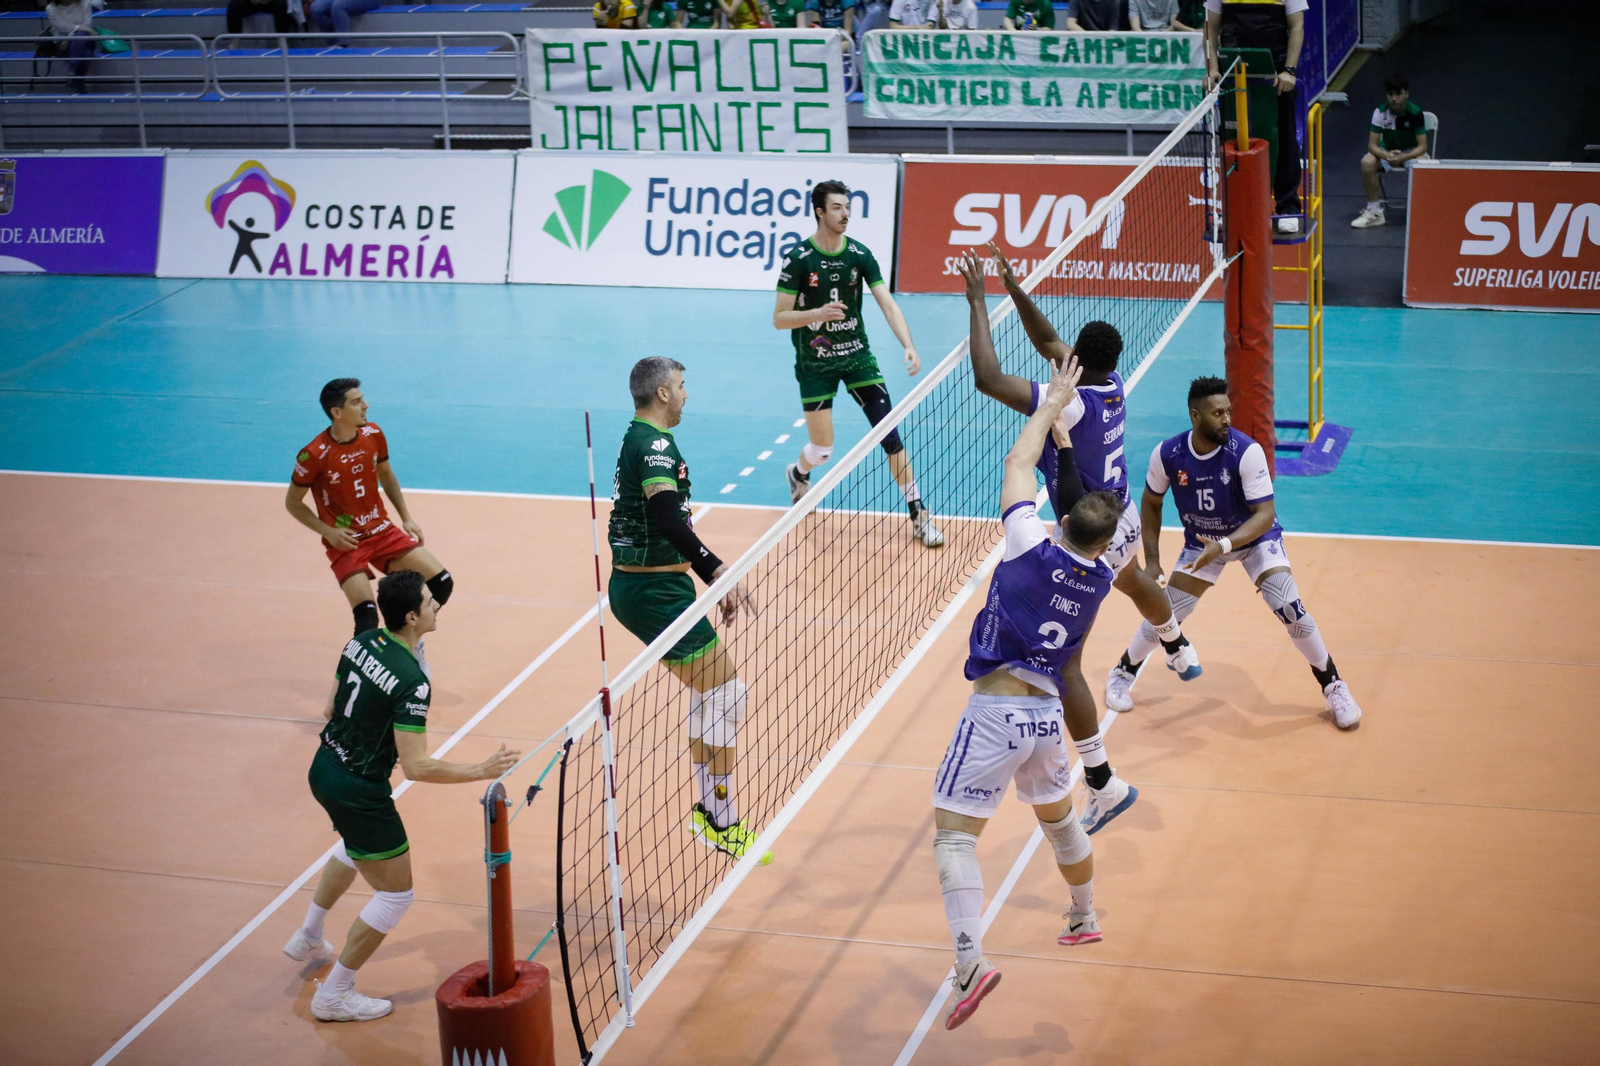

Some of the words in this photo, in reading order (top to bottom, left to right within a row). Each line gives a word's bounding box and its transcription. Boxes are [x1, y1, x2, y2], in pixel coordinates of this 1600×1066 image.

[1039, 36, 1191, 66] CAMPEON
[1021, 80, 1064, 108] LA
[647, 177, 870, 219] Fundacin
[305, 205, 406, 230] COSTA
[417, 205, 455, 231] DE
[948, 193, 1125, 250] SVM
[0, 227, 23, 244] DE
[26, 223, 106, 244] ALMERÍA
[645, 220, 802, 271] Unicaja
[269, 235, 454, 279] ALMERÍA
[1031, 258, 1105, 281] VLEIBOL
[1108, 261, 1200, 283] MASCULINA
[1453, 267, 1543, 288] SUPERLIGA
[829, 287, 839, 303] 9
[1103, 445, 1124, 484] 5
[354, 478, 366, 498] 5
[1196, 488, 1216, 511] 15
[1063, 577, 1096, 594] LÉLEMAN
[1050, 593, 1081, 617] FUNES
[361, 654, 400, 695] RENAN
[343, 670, 362, 718] 7
[1015, 720, 1060, 739] TIPSA
